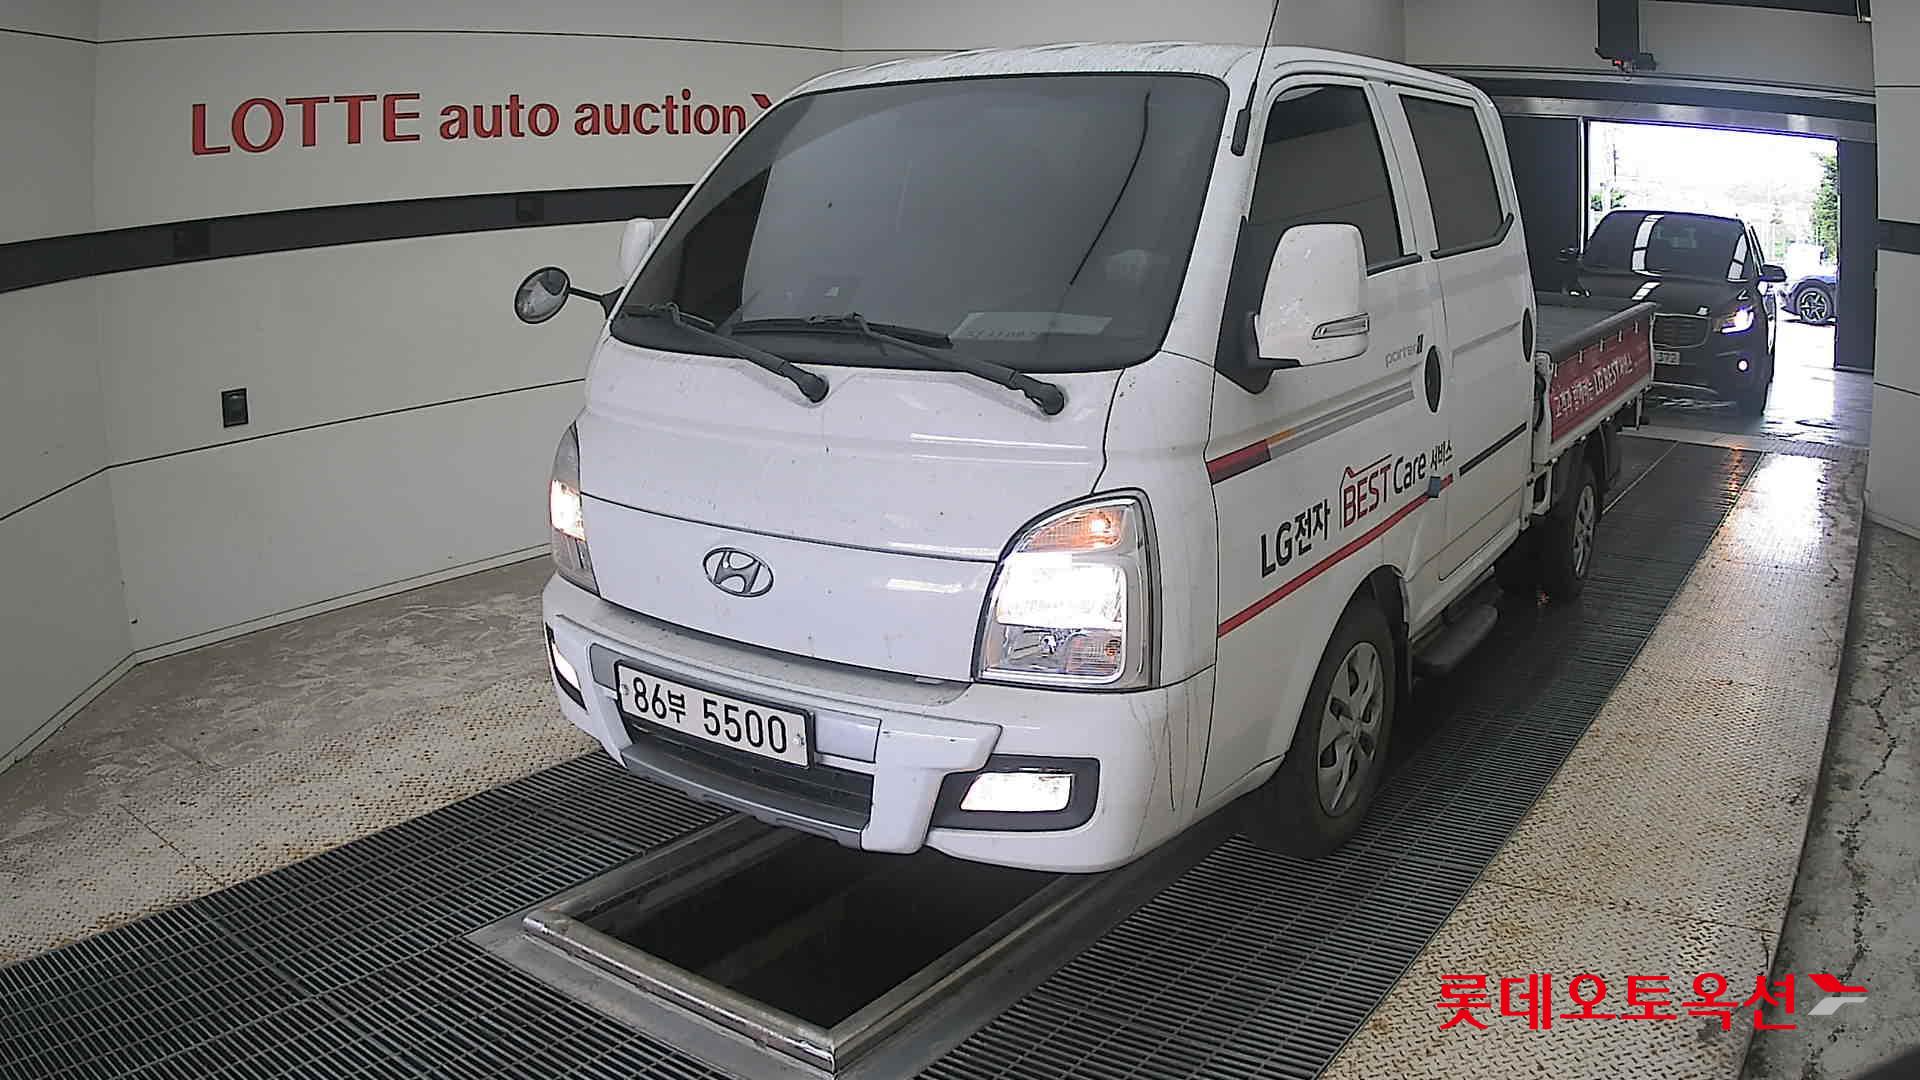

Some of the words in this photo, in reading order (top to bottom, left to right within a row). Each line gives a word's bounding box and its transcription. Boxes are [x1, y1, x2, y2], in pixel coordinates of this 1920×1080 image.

[191, 92, 421, 156] LOTTE
[438, 95, 560, 141] auto
[574, 88, 747, 137] auction
[1260, 499, 1331, 578] LG전자
[1342, 463, 1392, 529] BEST
[1393, 452, 1427, 495] Care
[1430, 440, 1453, 471] 서비스
[633, 677, 686, 724] 86부
[703, 698, 787, 754] 5500
